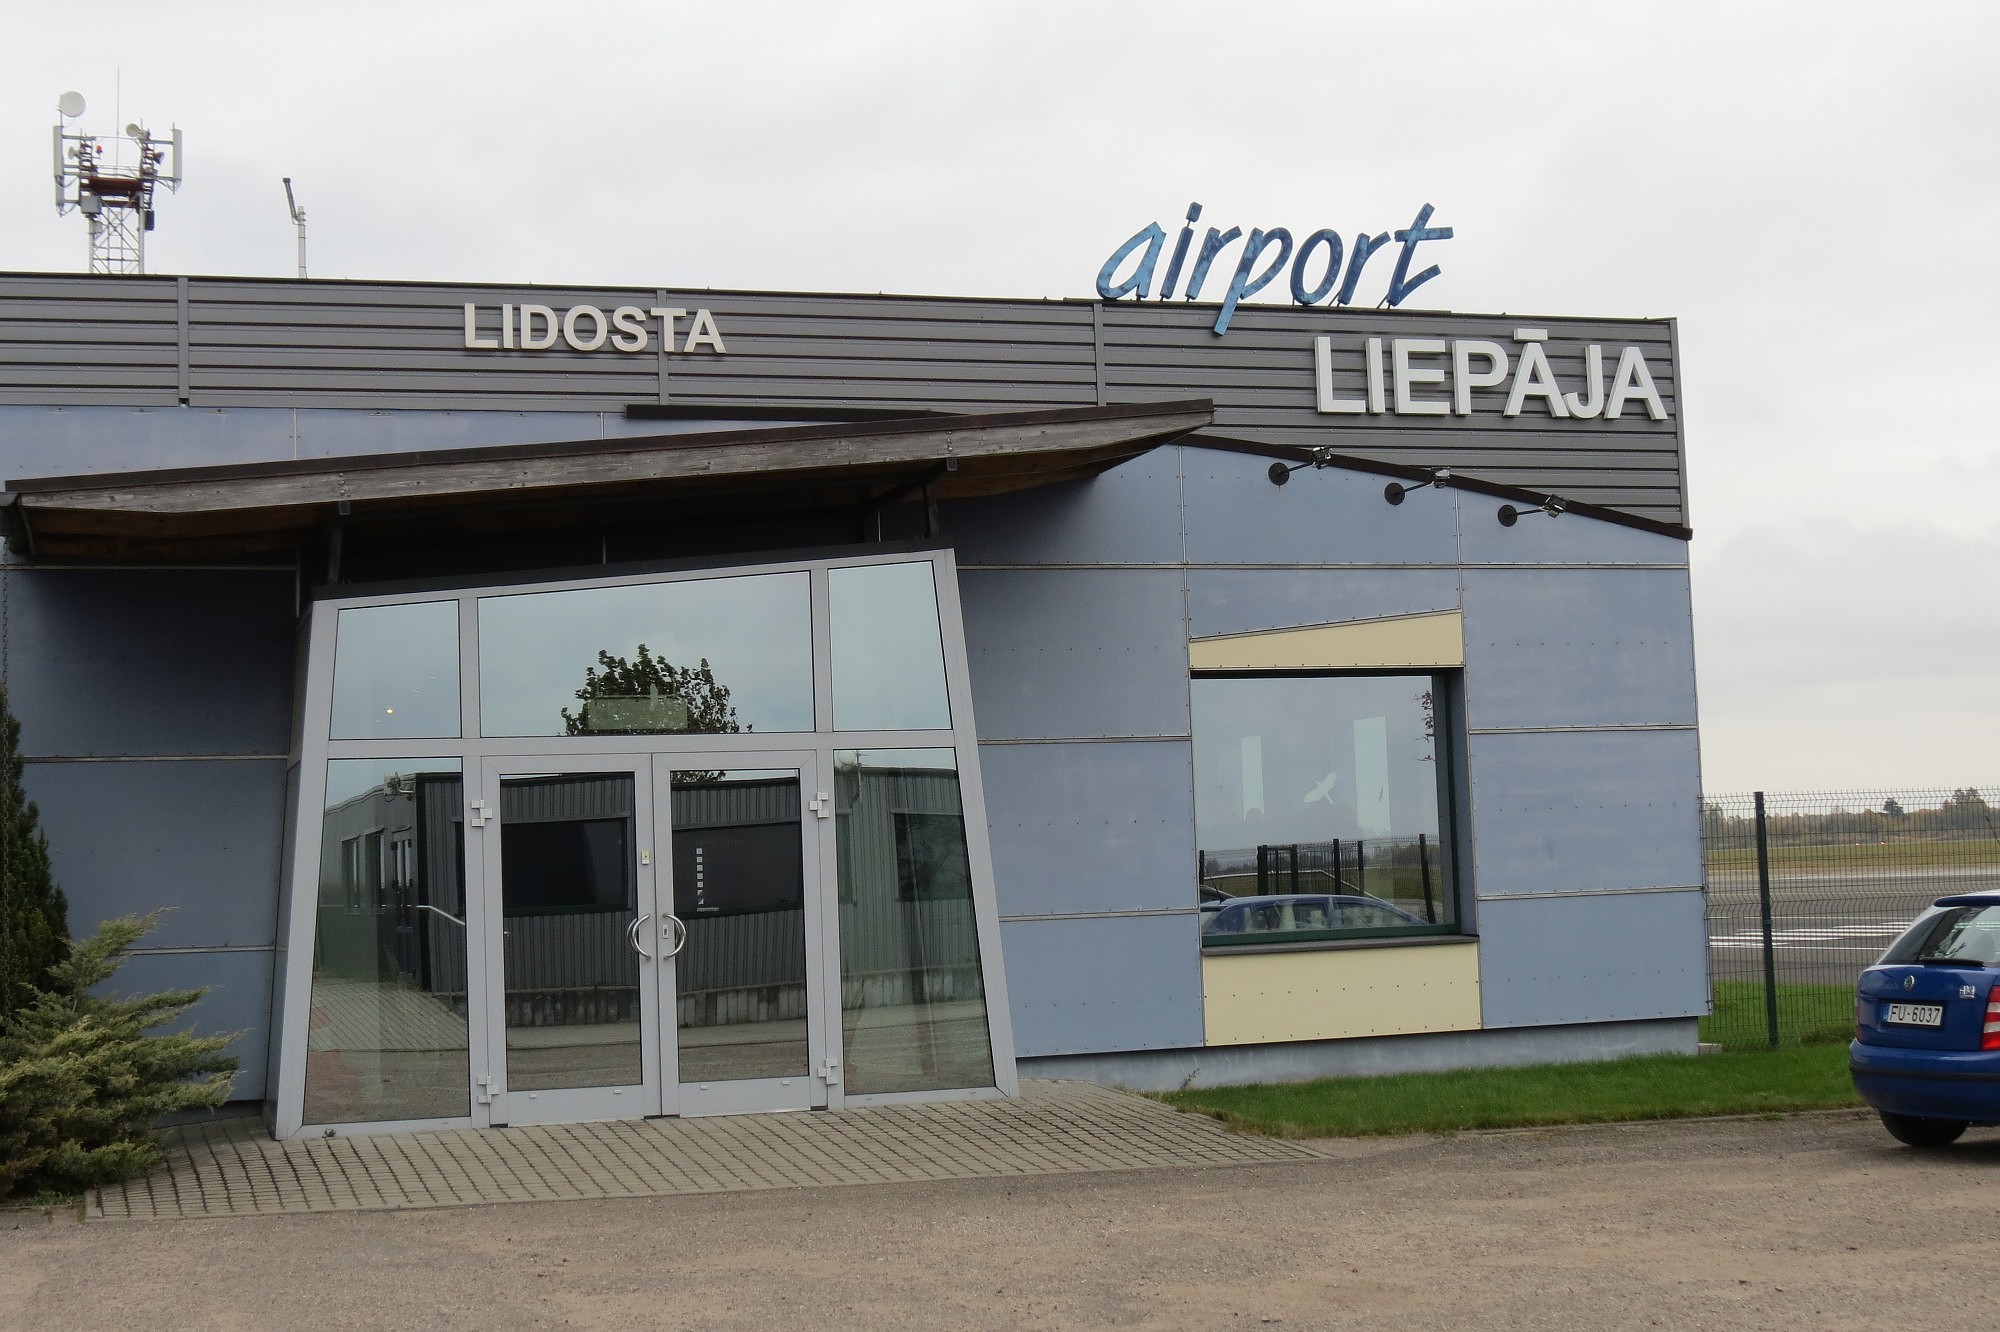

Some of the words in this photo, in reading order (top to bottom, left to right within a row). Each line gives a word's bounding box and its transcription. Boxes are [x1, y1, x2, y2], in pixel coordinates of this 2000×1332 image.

[1096, 202, 1454, 336] airport
[464, 303, 727, 354] LIDOSTA
[1314, 328, 1669, 421] LIEPĀJA
[1890, 1005, 1941, 1023] FU-6037
